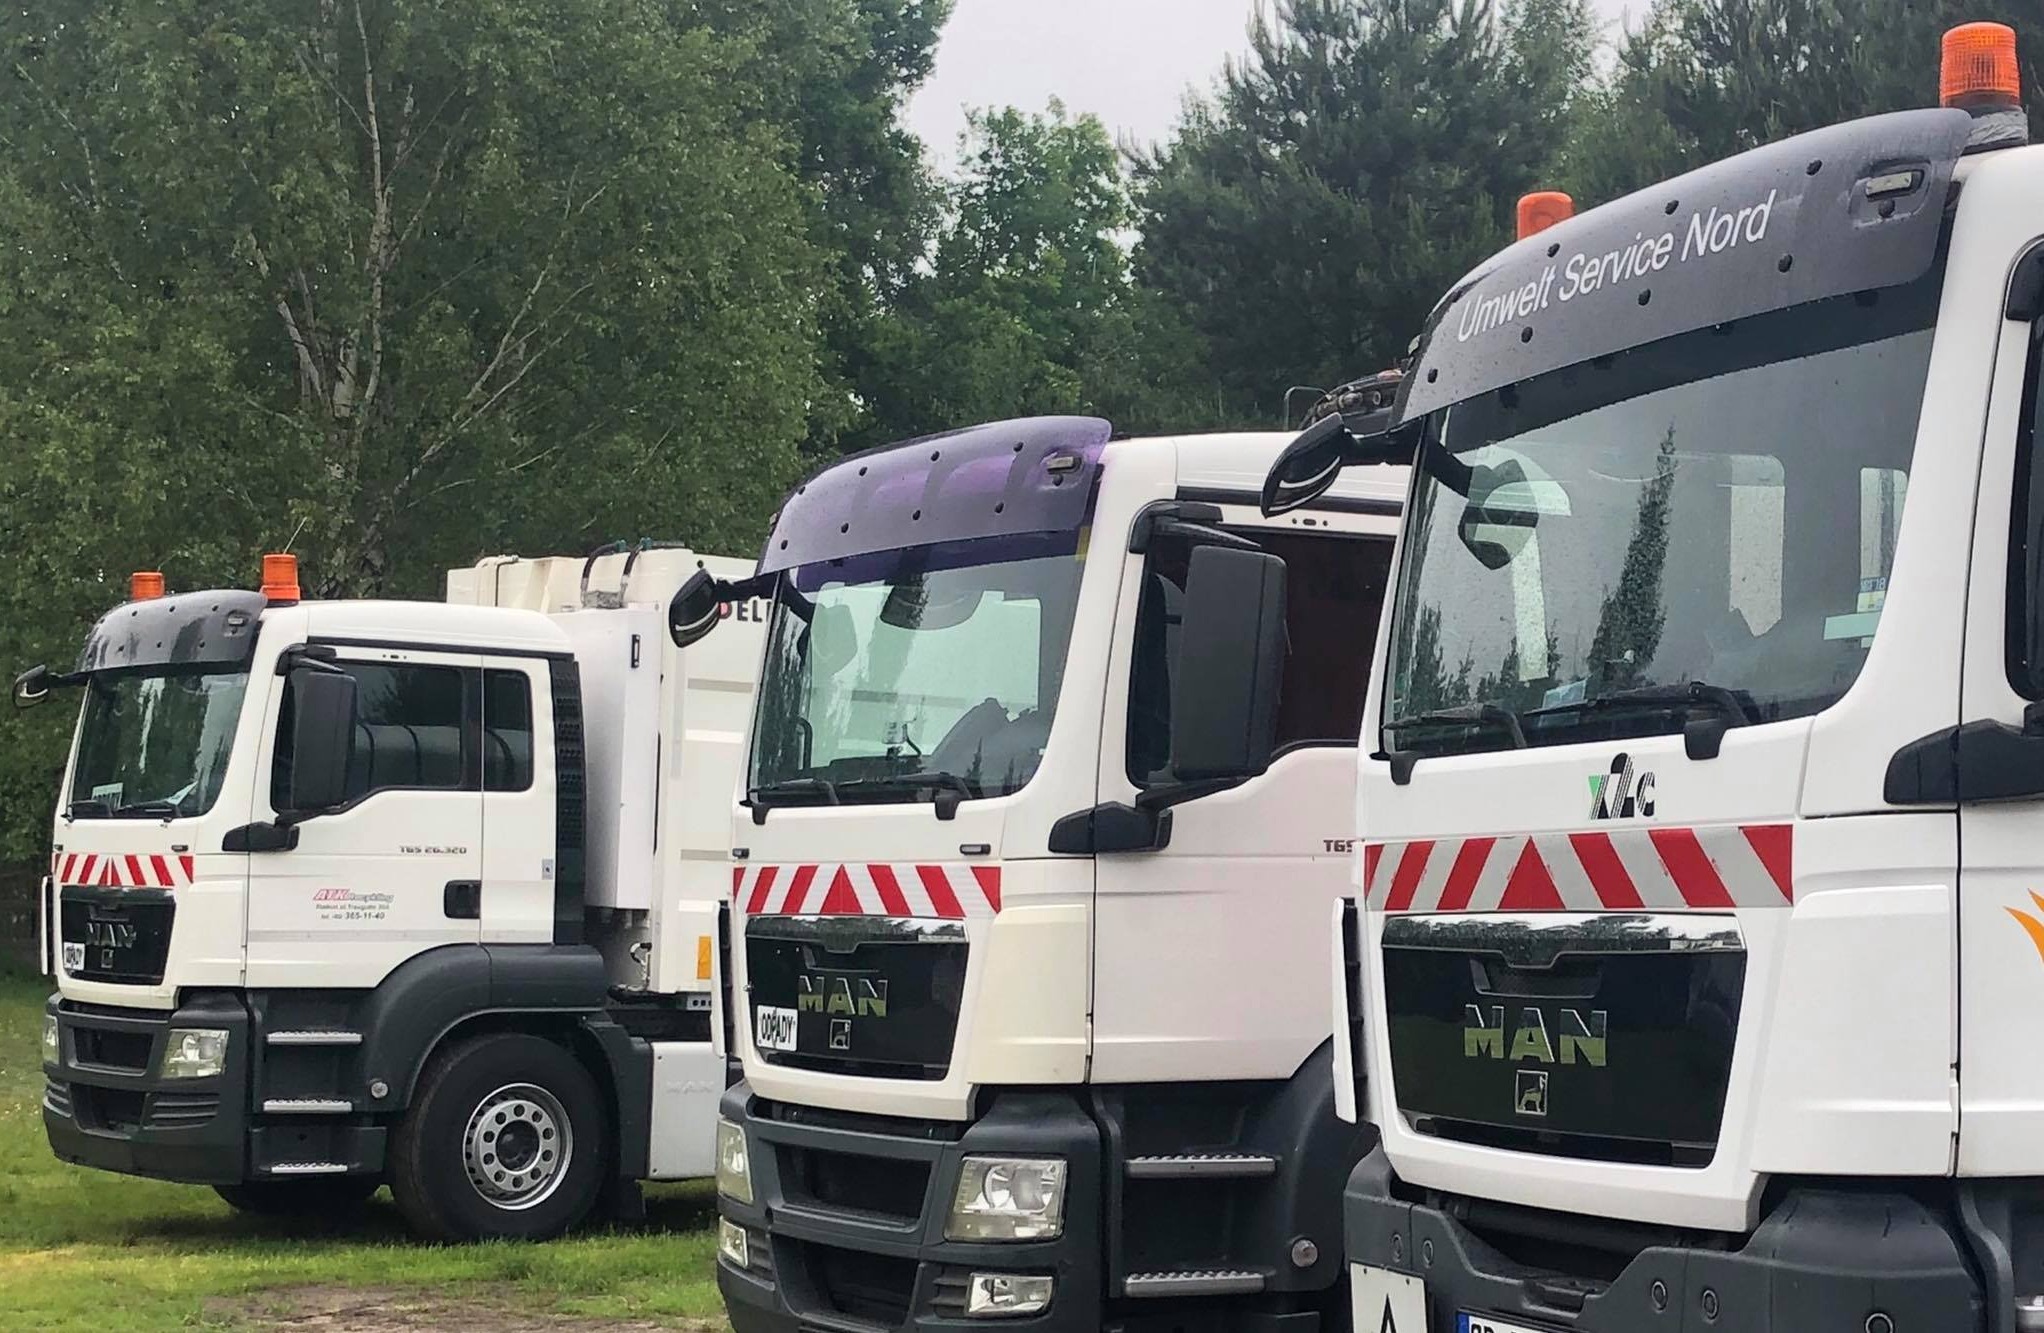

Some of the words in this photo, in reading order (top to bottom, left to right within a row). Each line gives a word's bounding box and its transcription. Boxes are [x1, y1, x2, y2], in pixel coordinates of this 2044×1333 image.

[1457, 261, 1558, 342] Umwelt
[1558, 231, 1675, 302] Service
[1680, 188, 1778, 262] Nord
[86, 922, 136, 949] MAN
[798, 975, 888, 1017] MAN
[1464, 1003, 1608, 1067] MAN
